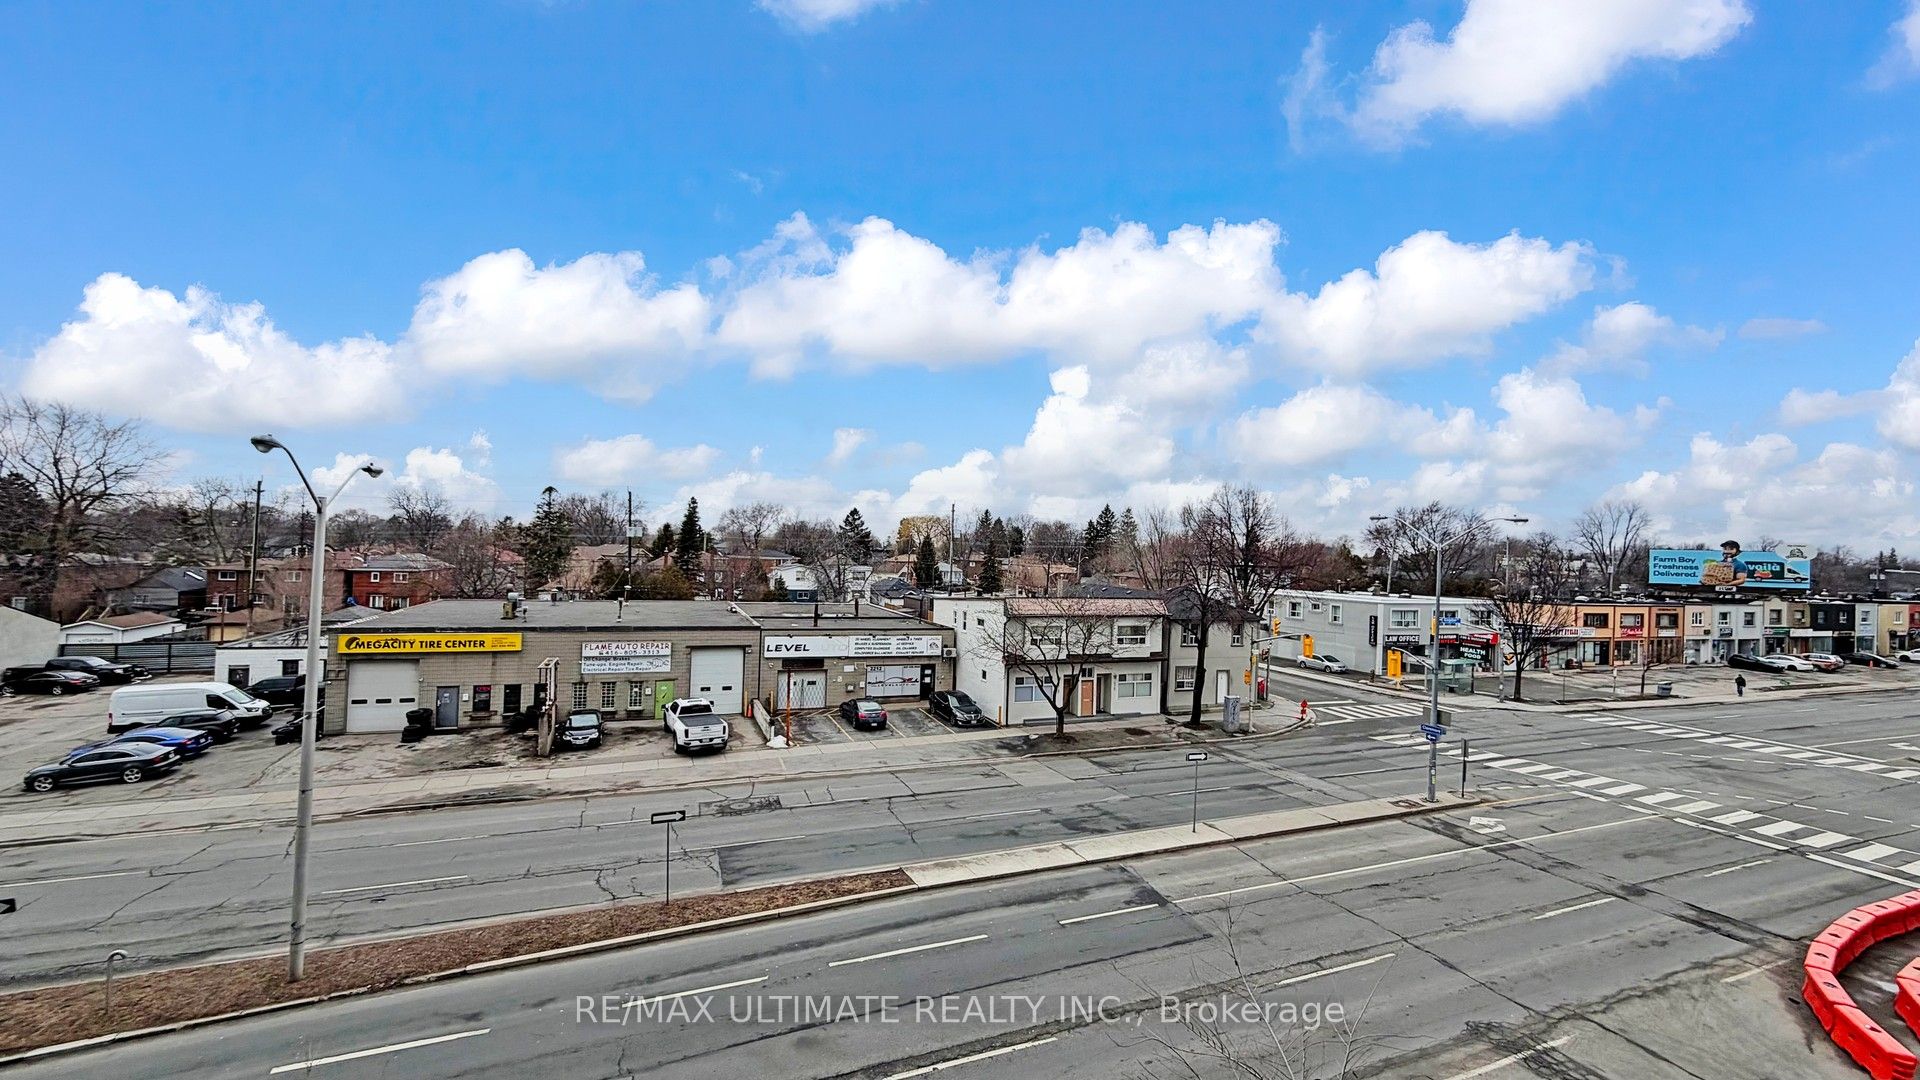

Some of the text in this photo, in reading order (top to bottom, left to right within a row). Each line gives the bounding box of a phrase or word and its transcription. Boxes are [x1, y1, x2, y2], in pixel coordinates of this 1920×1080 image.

[1653, 563, 1699, 571] Freshness
[1749, 562, 1781, 571] voilà
[354, 640, 416, 649] MEGACITY
[418, 640, 442, 648] TIRE
[445, 640, 486, 648] CENTER
[640, 642, 670, 650] REPAIR
[766, 644, 811, 652] LEVEL
[1460, 647, 1485, 655] HEALTH
